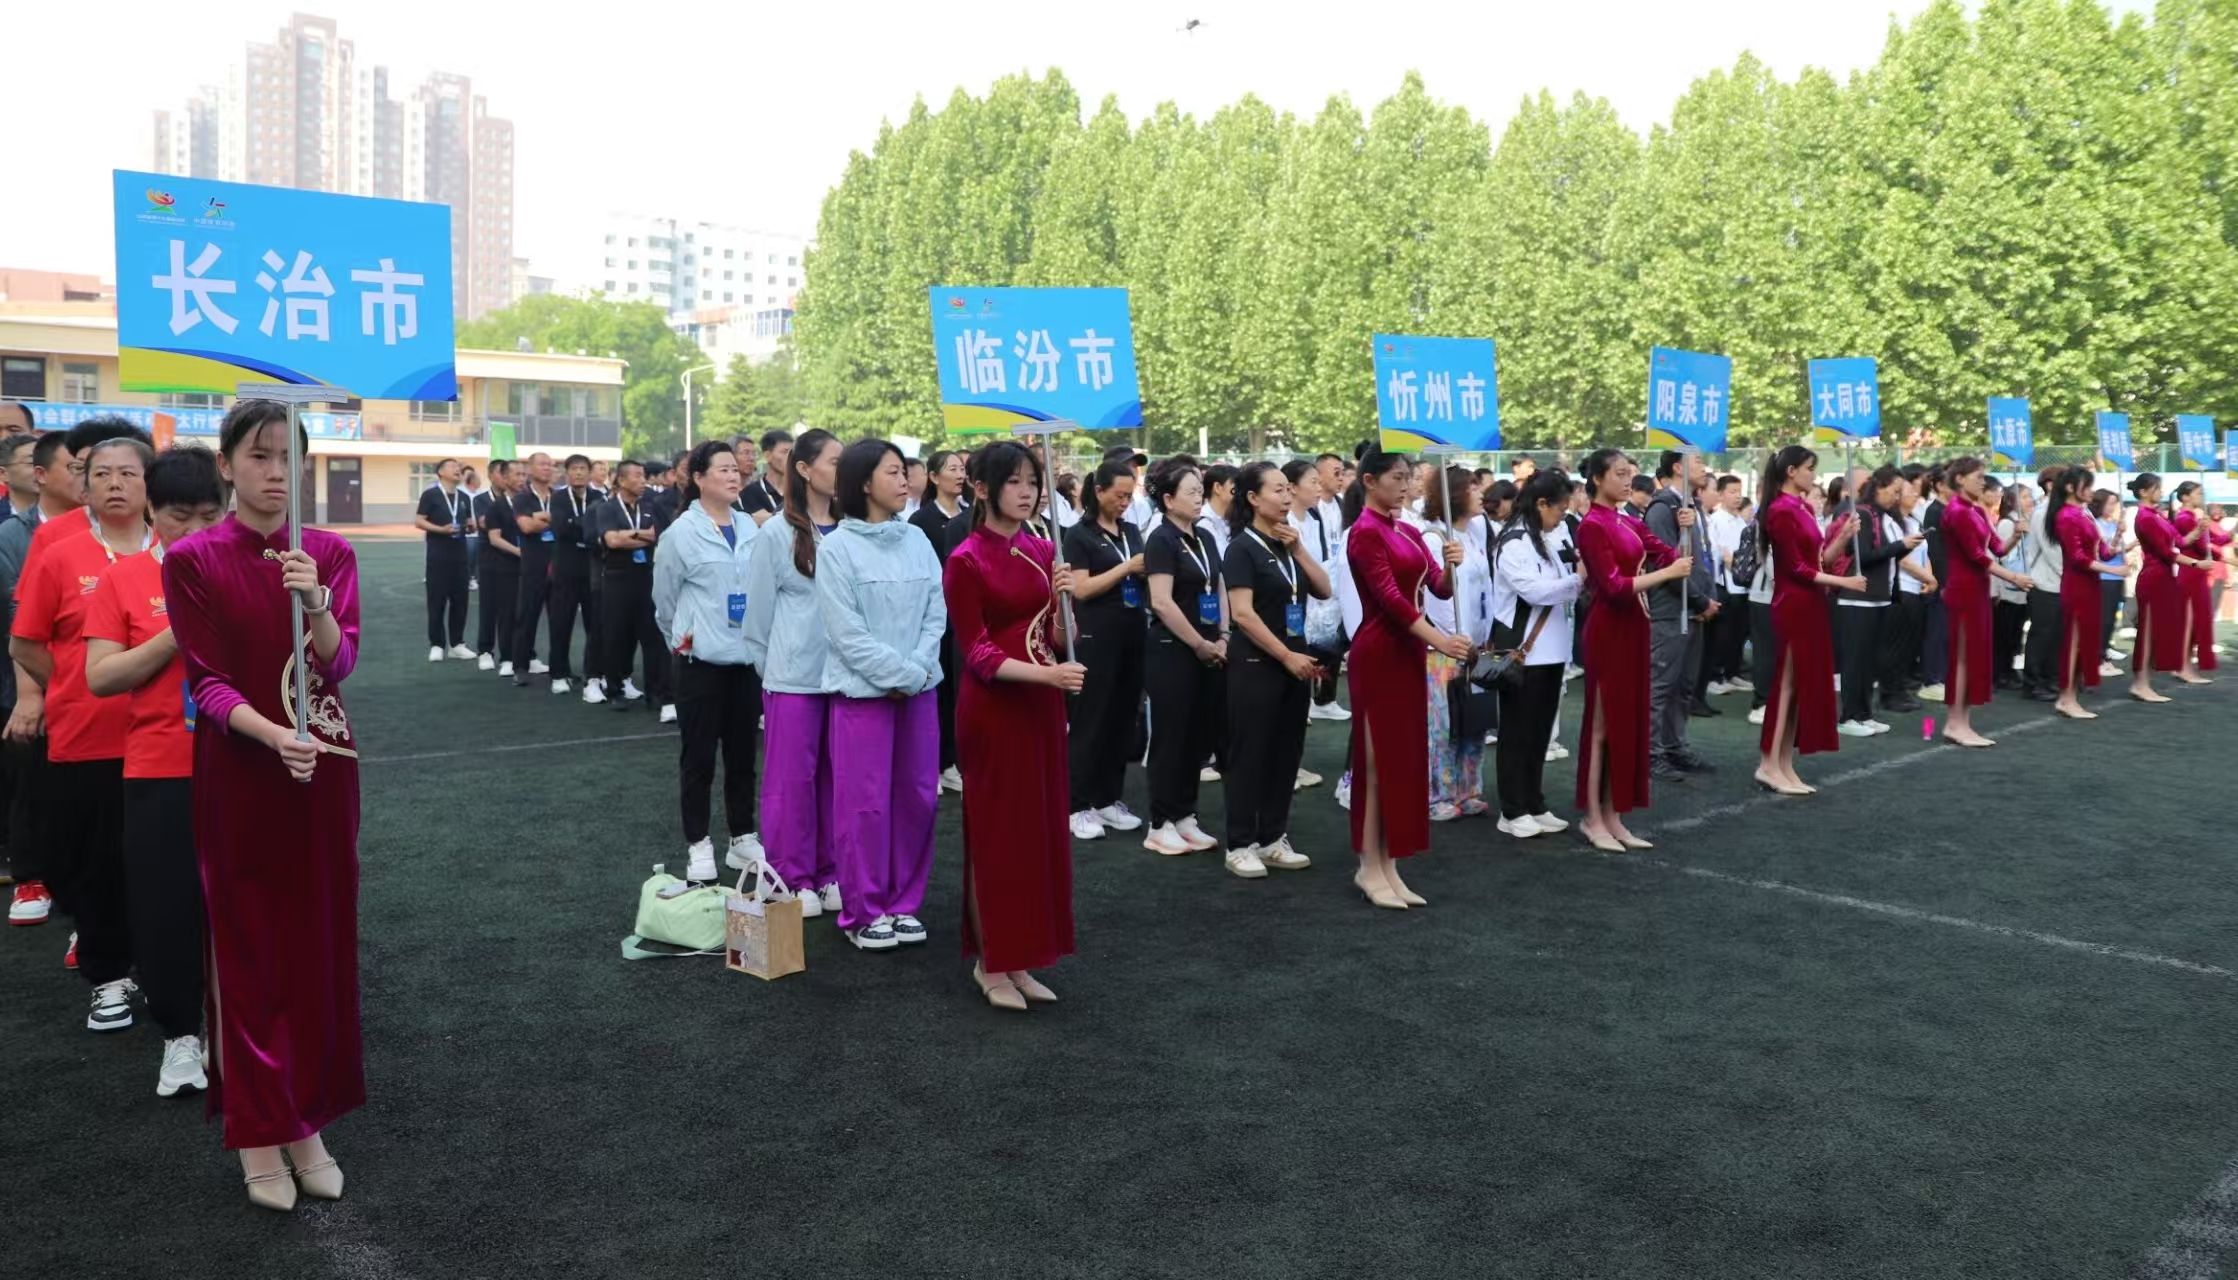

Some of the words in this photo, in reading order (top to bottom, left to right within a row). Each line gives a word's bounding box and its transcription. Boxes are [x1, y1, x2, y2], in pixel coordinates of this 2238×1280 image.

[151, 239, 424, 346] 长治市
[956, 329, 1115, 394] 临汾市
[1389, 369, 1486, 421] 忻州市
[1656, 380, 1722, 426] 阳泉市
[1817, 381, 1872, 420] 大同市
[1994, 417, 2027, 448] 太原市
